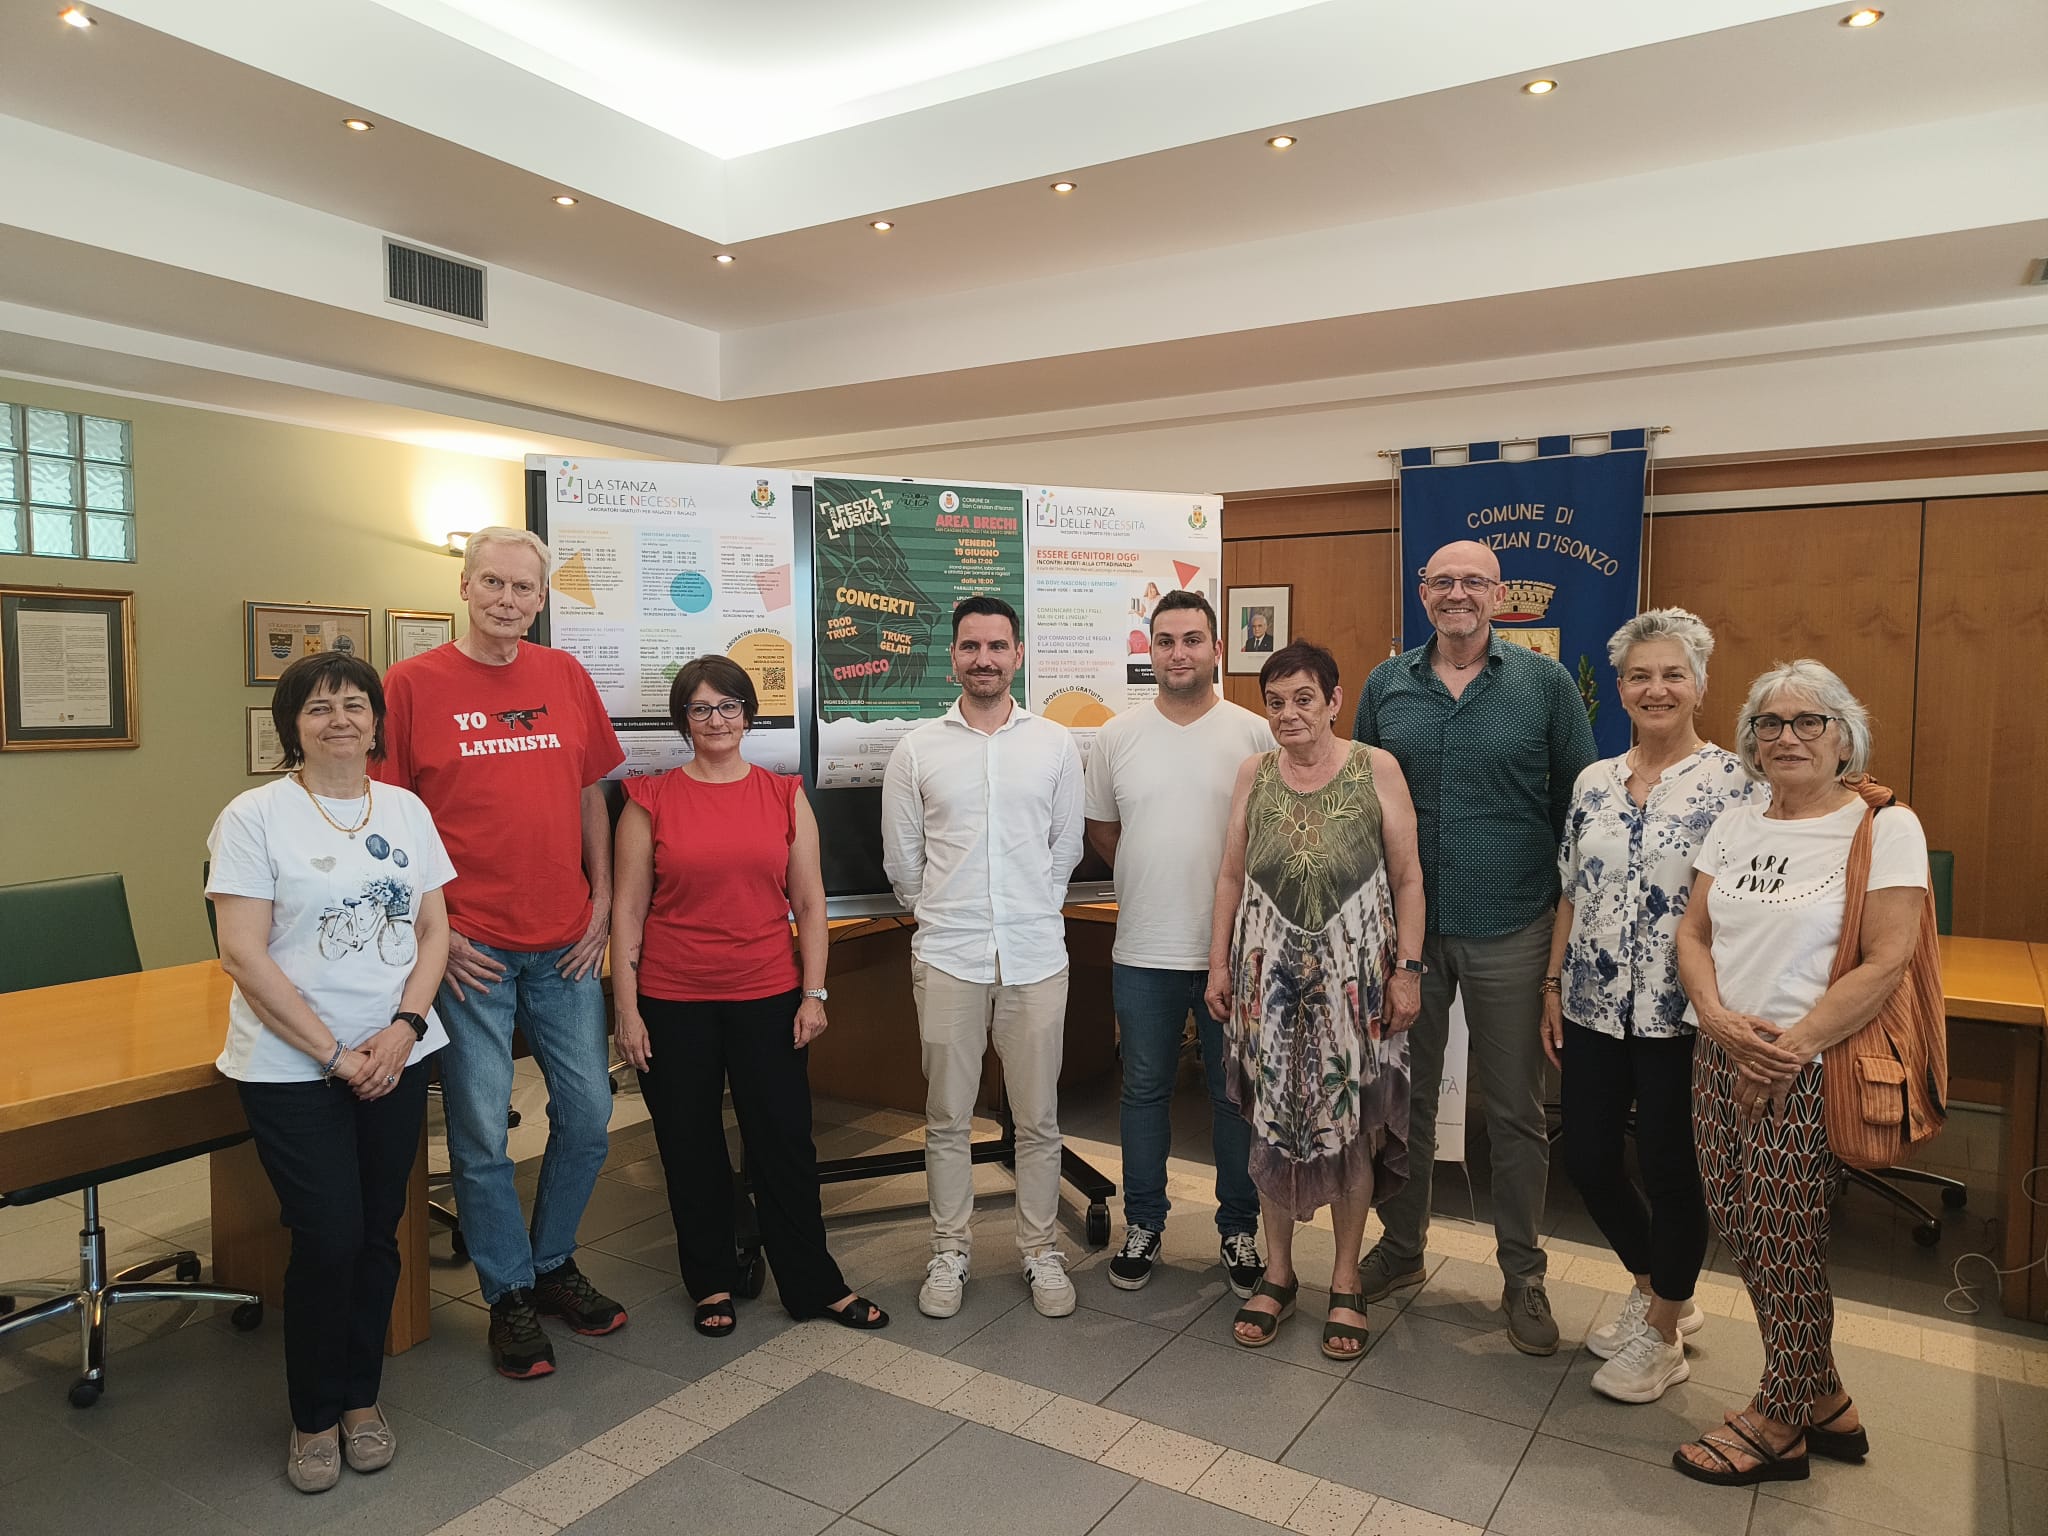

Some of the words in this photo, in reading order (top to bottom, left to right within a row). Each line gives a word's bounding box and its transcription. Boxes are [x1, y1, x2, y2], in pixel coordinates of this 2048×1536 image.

[588, 480, 604, 490] LA
[607, 480, 657, 493] STANZA
[588, 493, 627, 506] DELLE
[630, 494, 697, 508] NECESSITÀ
[835, 497, 878, 518] FESTA
[832, 508, 883, 532] MUSICA
[1060, 506, 1074, 515] LA
[1076, 506, 1115, 517] STANZA
[1467, 503, 1545, 529] COMUNE
[1555, 506, 1574, 525] DI
[936, 514, 970, 528] AREA
[973, 516, 1017, 531] BRECHI
[1060, 518, 1091, 529] DELLE
[1094, 519, 1146, 530] NECESSITÀ
[958, 537, 996, 548] VENERDÌ
[965, 548, 999, 557] GIUGNO
[1037, 549, 1069, 559] ESSERE
[1071, 551, 1114, 561] GENITORI
[1117, 552, 1140, 561] OGGI
[1479, 531, 1530, 551] NZIAN
[1536, 532, 1619, 576] D'ISONZO
[836, 587, 915, 617] CONCERTI
[827, 616, 852, 629] FOOD
[725, 630, 753, 652] LABORATORI
[827, 626, 858, 640] TRUCK
[882, 630, 913, 645] TRUCK
[880, 641, 911, 655] GELATI
[833, 659, 890, 681] CHIOSCO
[1043, 685, 1075, 706] SPORTELLO
[1075, 686, 1104, 703] GRATUITO
[453, 711, 488, 731] YO
[459, 733, 561, 757] LATINISTA
[1735, 874, 1785, 894] PWR
